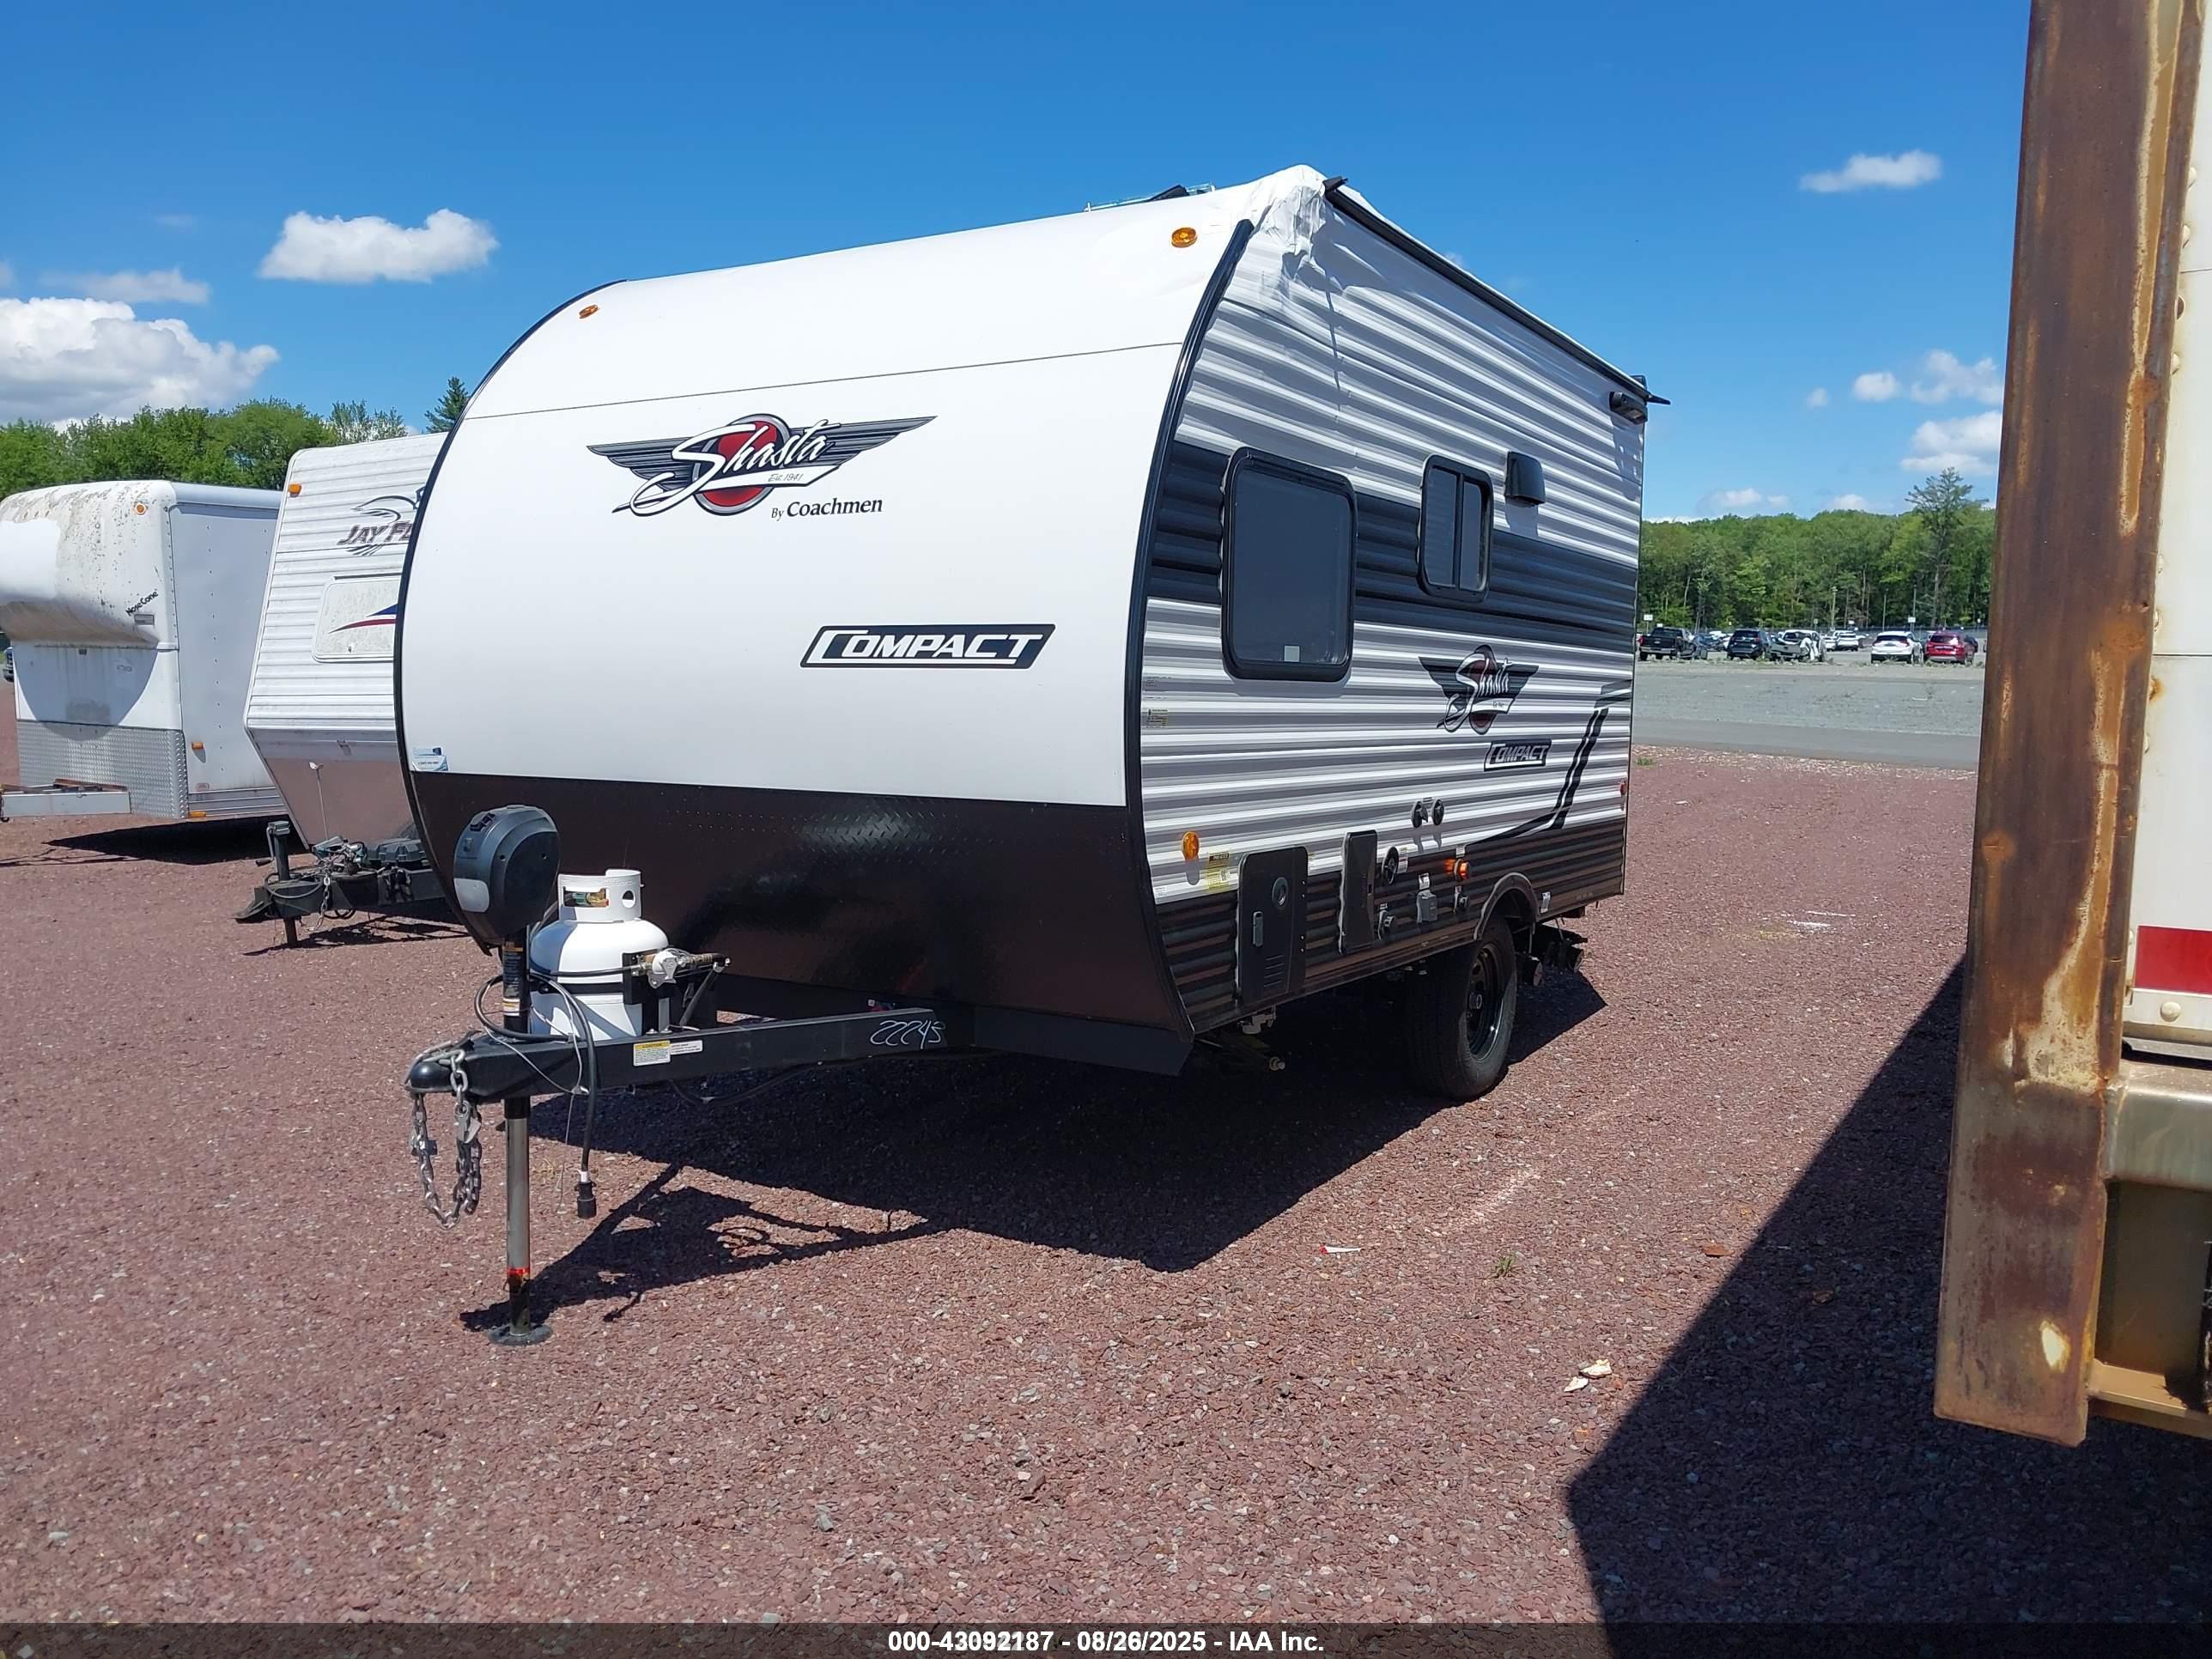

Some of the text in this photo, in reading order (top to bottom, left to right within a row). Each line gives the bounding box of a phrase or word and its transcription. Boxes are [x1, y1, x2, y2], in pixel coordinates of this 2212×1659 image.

[612, 419, 842, 516] Shasta
[783, 473, 805, 482] 1941
[771, 497, 883, 521] By Coachmen
[337, 525, 389, 545] JAY
[806, 629, 1043, 664] COMPACT
[1437, 652, 1512, 732] Shasta
[1486, 743, 1549, 769] COMPACT
